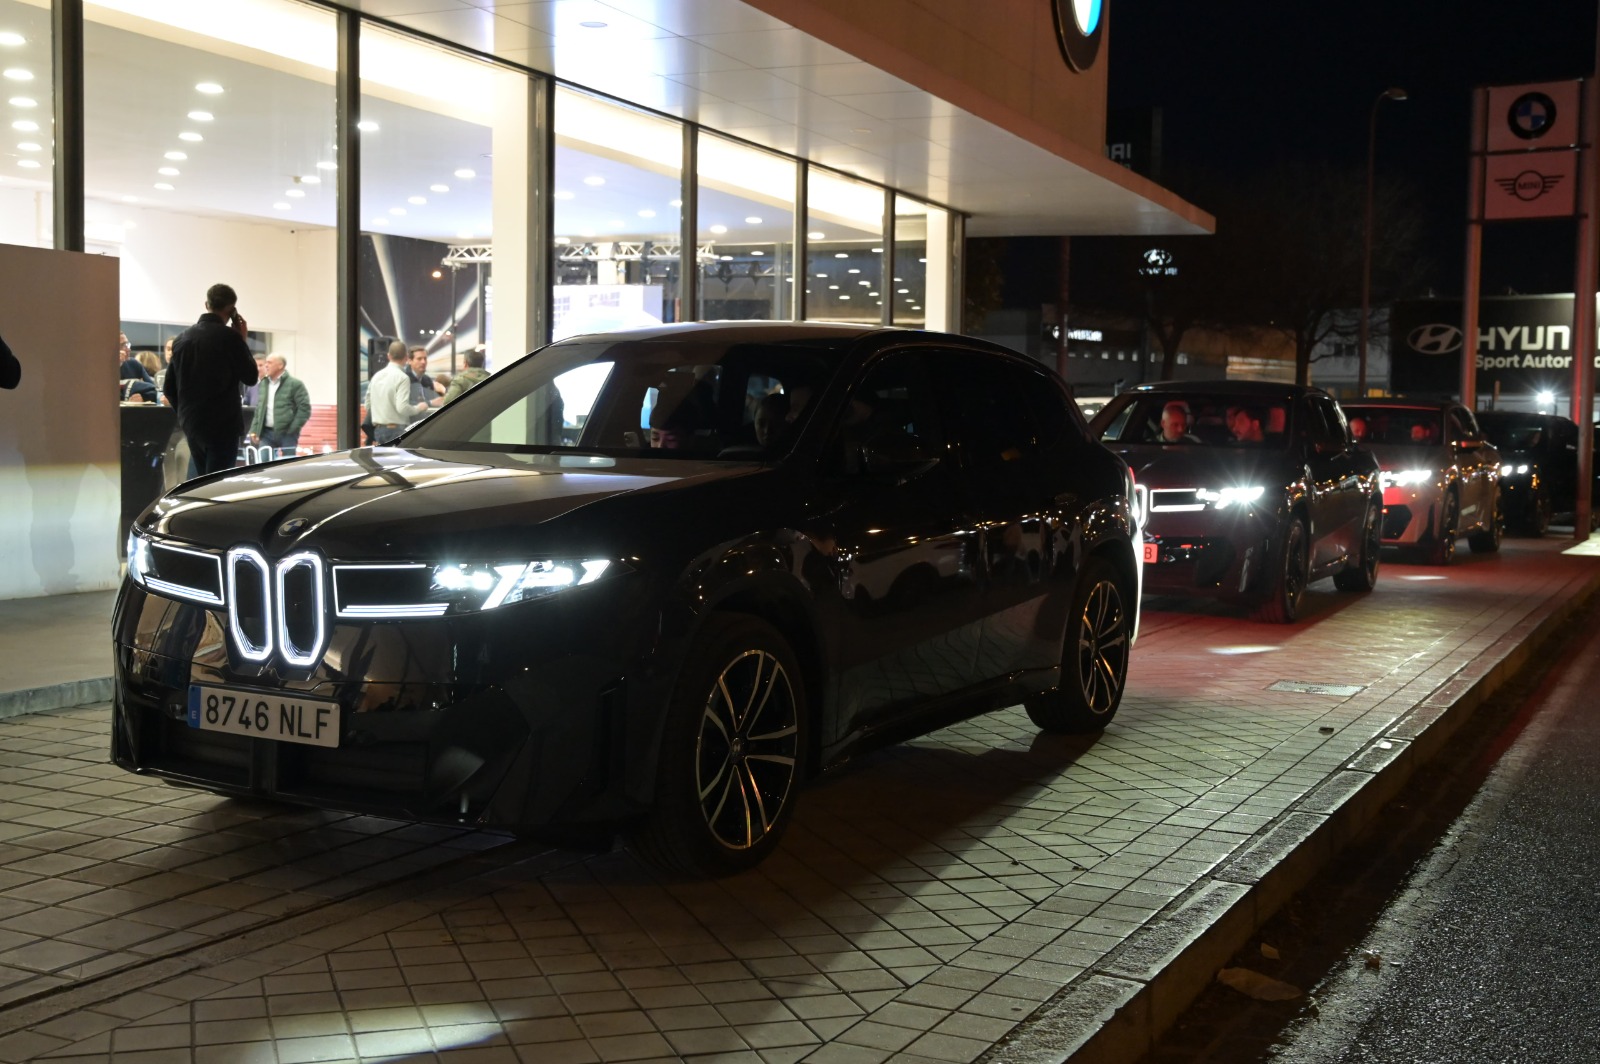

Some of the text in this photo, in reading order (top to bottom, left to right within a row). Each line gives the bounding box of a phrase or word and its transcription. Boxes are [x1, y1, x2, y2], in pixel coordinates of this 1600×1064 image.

[1105, 142, 1132, 160] AI
[1476, 325, 1600, 351] HYUN
[1475, 354, 1520, 371] Sport
[191, 694, 331, 740] E 8746 NLF
